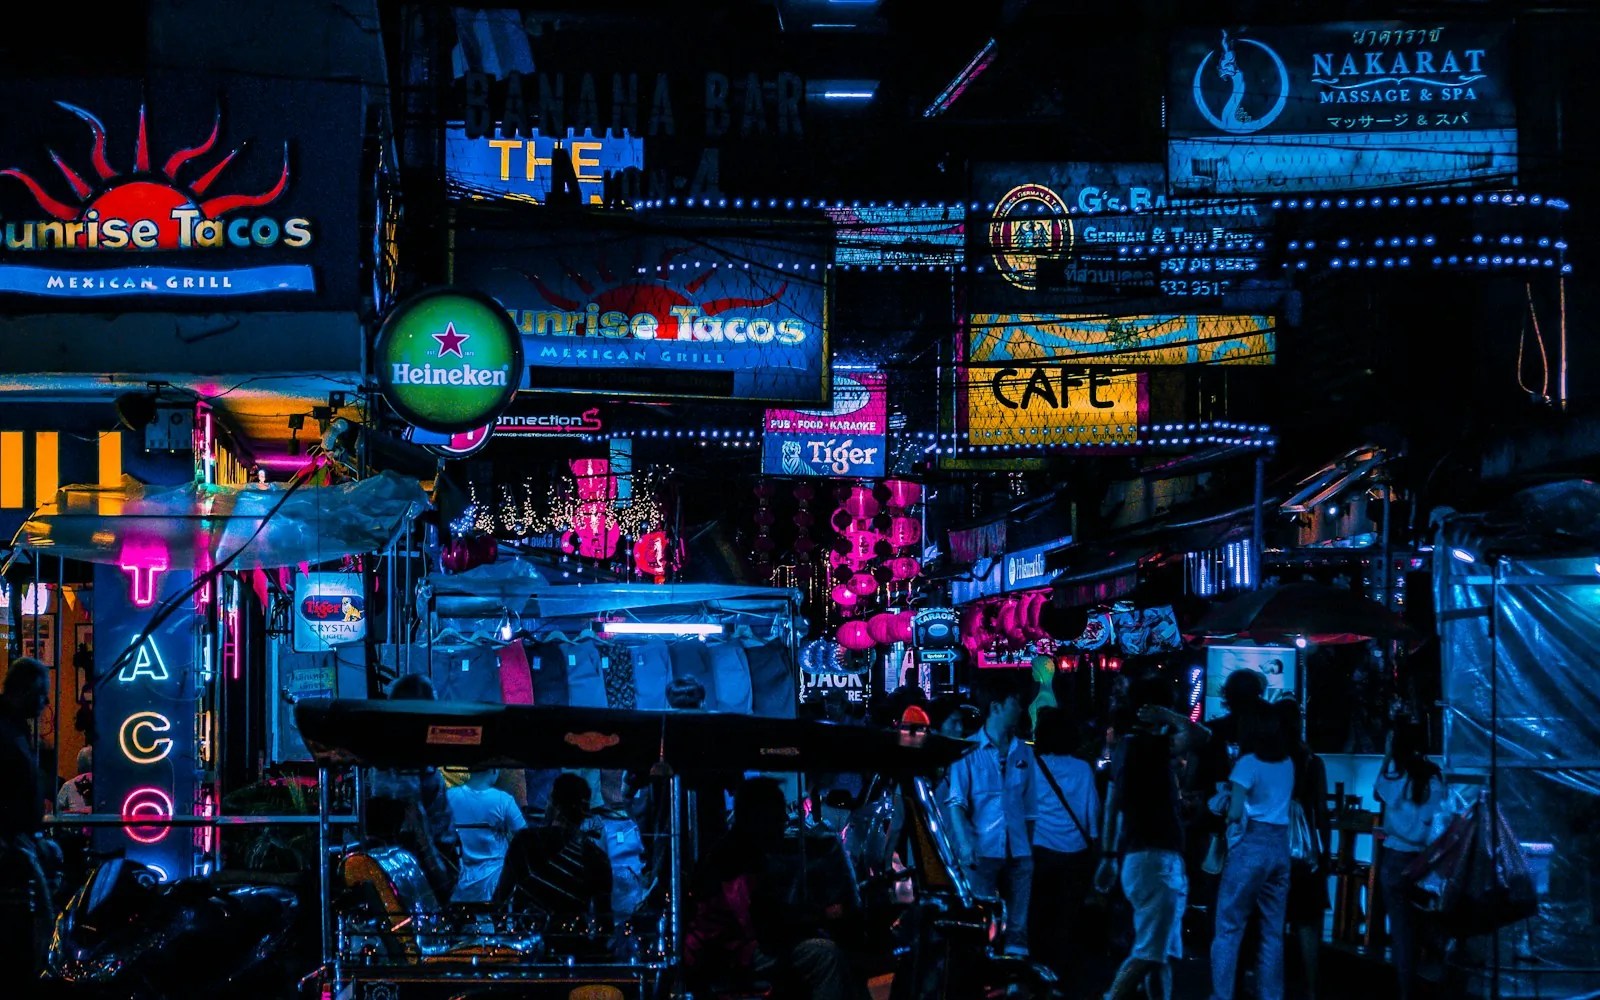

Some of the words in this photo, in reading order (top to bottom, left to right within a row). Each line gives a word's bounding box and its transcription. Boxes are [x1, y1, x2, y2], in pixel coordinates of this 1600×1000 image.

[1311, 49, 1487, 77] NAKARAT
[705, 70, 804, 137] BAR
[1320, 89, 1411, 104] MASSAGE
[1420, 88, 1432, 101] &
[1441, 87, 1477, 101] SPA
[1327, 113, 1408, 128] マッサージ
[1417, 115, 1428, 126] &
[1435, 112, 1469, 126] スパ
[489, 140, 602, 182] THE
[0, 210, 160, 249] unrise
[170, 203, 312, 249] Tacos
[1084, 227, 1146, 243] GERMAN
[1152, 227, 1165, 243] &
[1171, 228, 1208, 243] THAI
[47, 274, 153, 289] MEXICAN
[166, 276, 233, 288] GRILL
[509, 303, 659, 338] unrise
[669, 305, 806, 344] Tacos
[540, 347, 646, 362] MEXICAN
[661, 350, 725, 364] GRILL
[391, 363, 507, 387] Heineken
[770, 419, 791, 429] PUB
[797, 420, 823, 430] FOOD
[830, 421, 876, 431] KARAOKE
[807, 438, 878, 475] Tiger
[304, 598, 341, 619] Tiger
[310, 624, 358, 633] CRYSTAL
[806, 673, 863, 688] JACK
